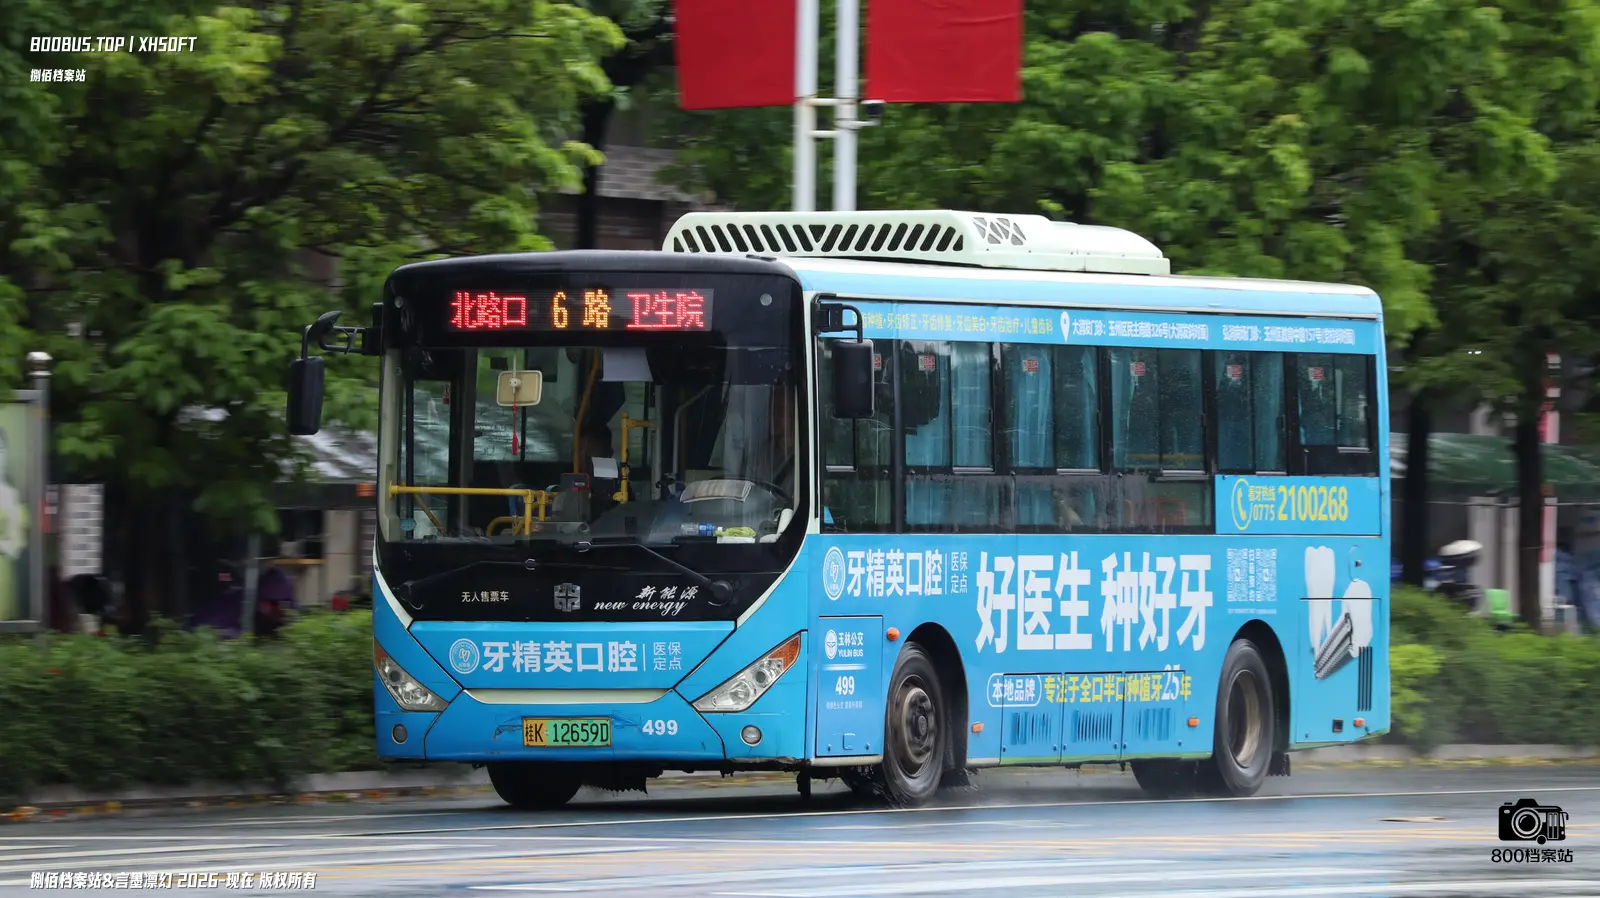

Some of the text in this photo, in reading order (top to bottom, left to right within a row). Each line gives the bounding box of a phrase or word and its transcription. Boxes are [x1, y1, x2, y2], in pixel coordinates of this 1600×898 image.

[450, 289, 704, 329] 北路口 6 路 卫生院
[1277, 485, 1349, 521] 2100268
[950, 552, 968, 571] 医保
[847, 549, 943, 597] 牙精英口腔
[635, 584, 699, 601] 新能源
[950, 575, 968, 594] 定点
[461, 590, 510, 603] 无人售票车
[975, 551, 1093, 654] 好医生
[1100, 551, 1214, 653] 种好牙
[594, 601, 688, 616] new energy
[653, 642, 682, 656] 医保
[838, 632, 864, 647] 玉林公交
[482, 640, 638, 673] 牙精英口腔
[837, 649, 864, 658] YULIN BUS
[653, 656, 682, 671] 定点
[835, 675, 855, 695] 499
[992, 678, 1036, 702] 本地品牌
[642, 719, 679, 736] 499
